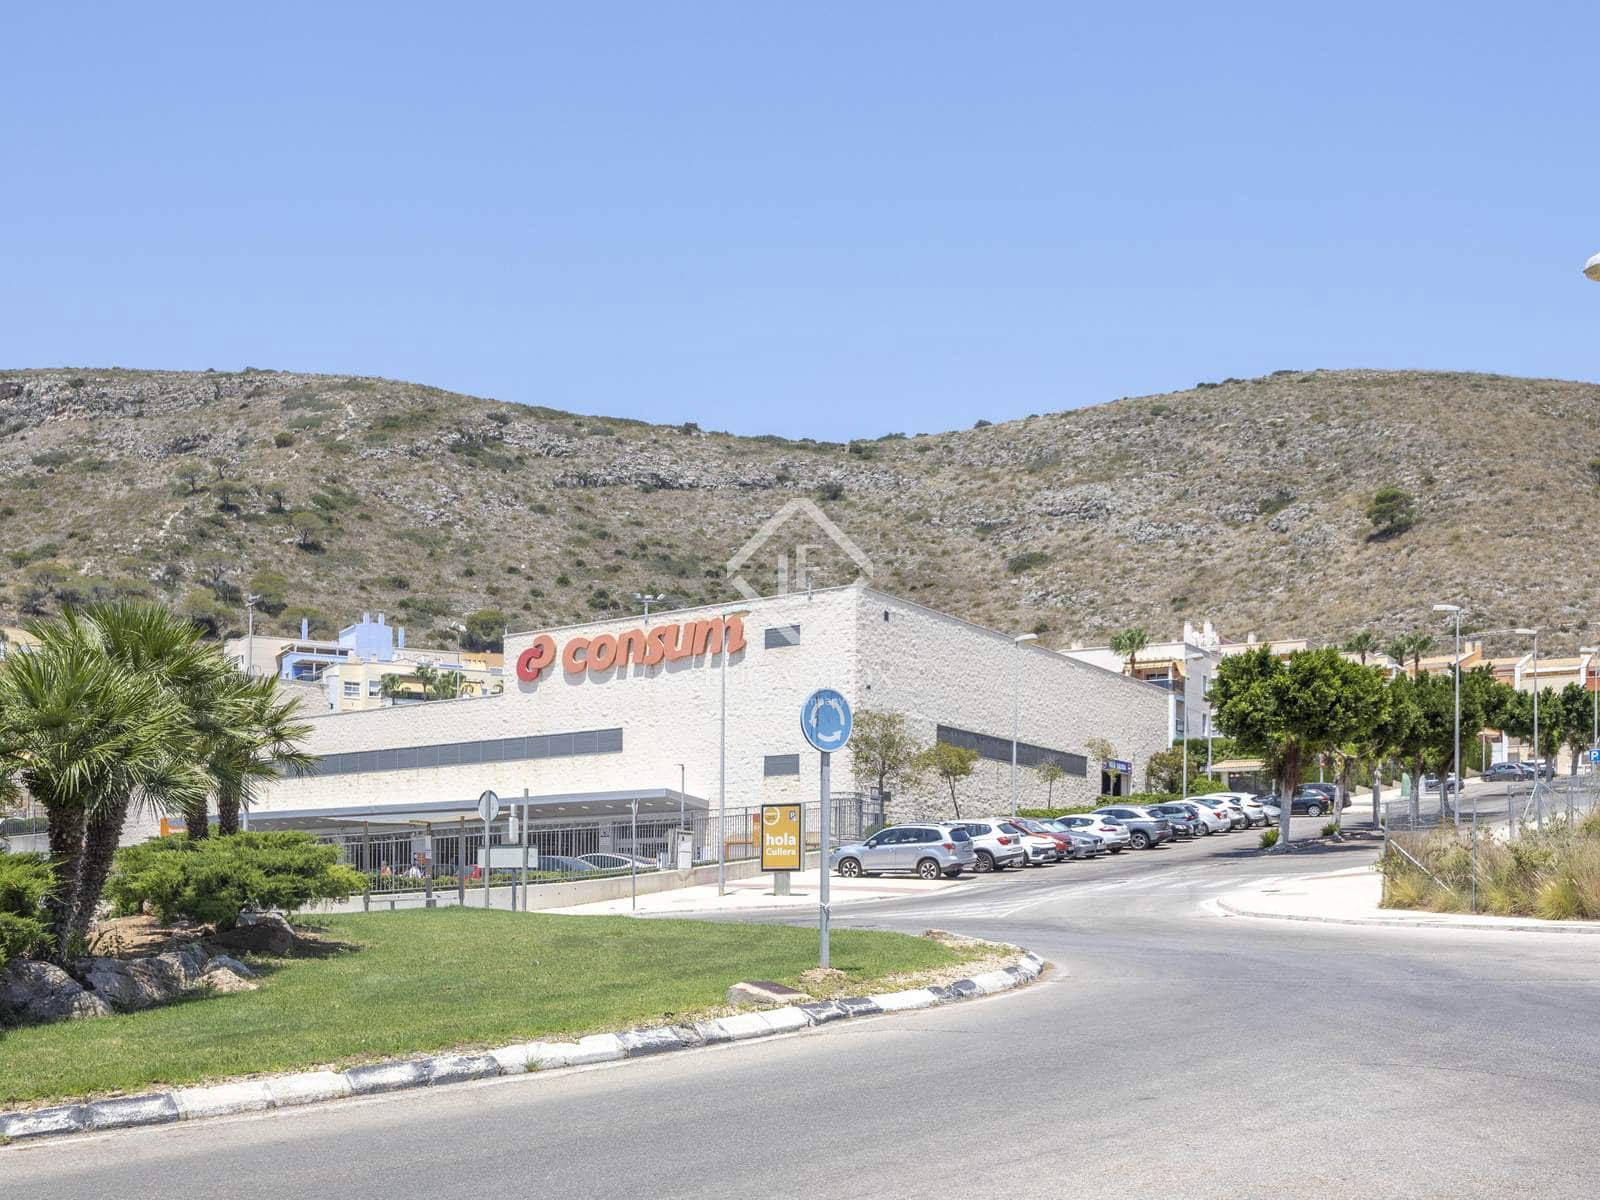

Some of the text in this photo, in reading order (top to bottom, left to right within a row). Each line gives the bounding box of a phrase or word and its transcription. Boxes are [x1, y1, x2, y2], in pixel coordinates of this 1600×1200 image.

[562, 617, 747, 673] consum
[1590, 751, 1599, 761] P
[766, 832, 796, 846] hola
[766, 847, 797, 856] Cullera
